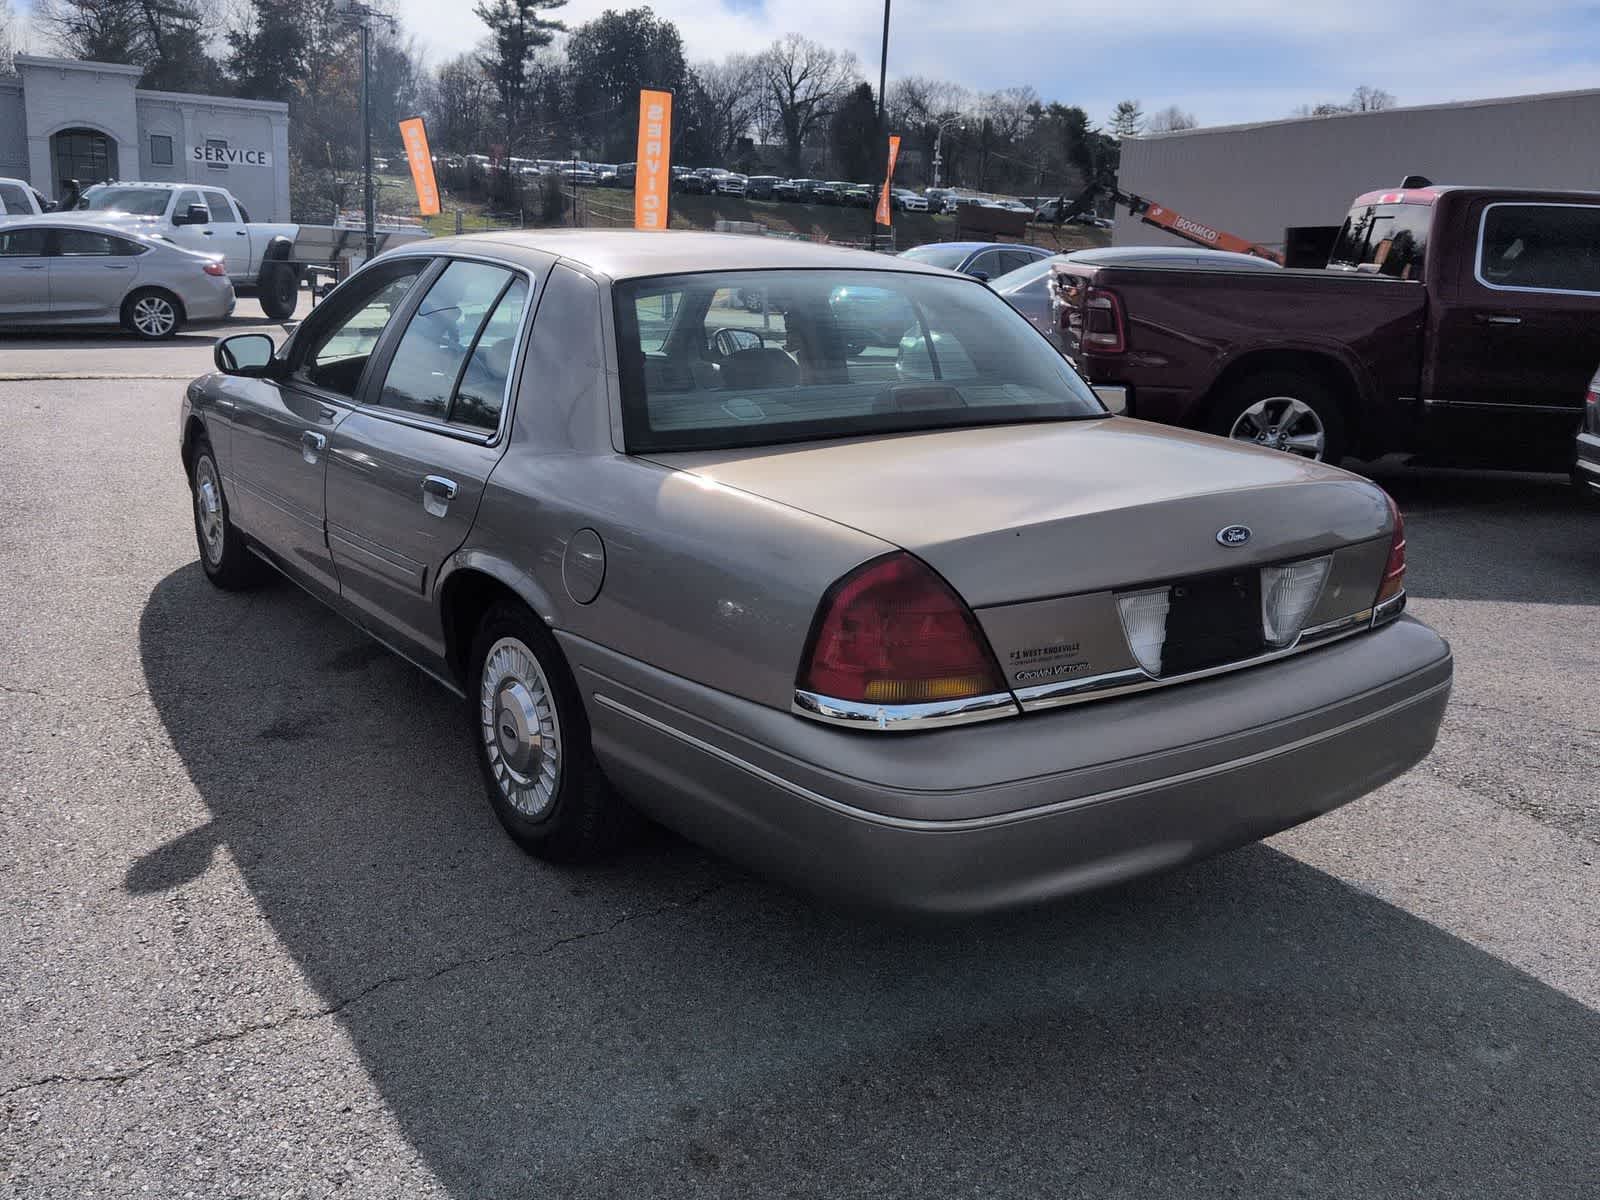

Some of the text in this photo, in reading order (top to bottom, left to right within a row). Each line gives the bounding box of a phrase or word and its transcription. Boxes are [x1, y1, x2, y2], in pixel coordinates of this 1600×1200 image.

[193, 146, 266, 165] SERVICE
[1176, 217, 1217, 240] BOOMCO
[1227, 529, 1247, 542] Ford
[1023, 648, 1041, 658] WEST
